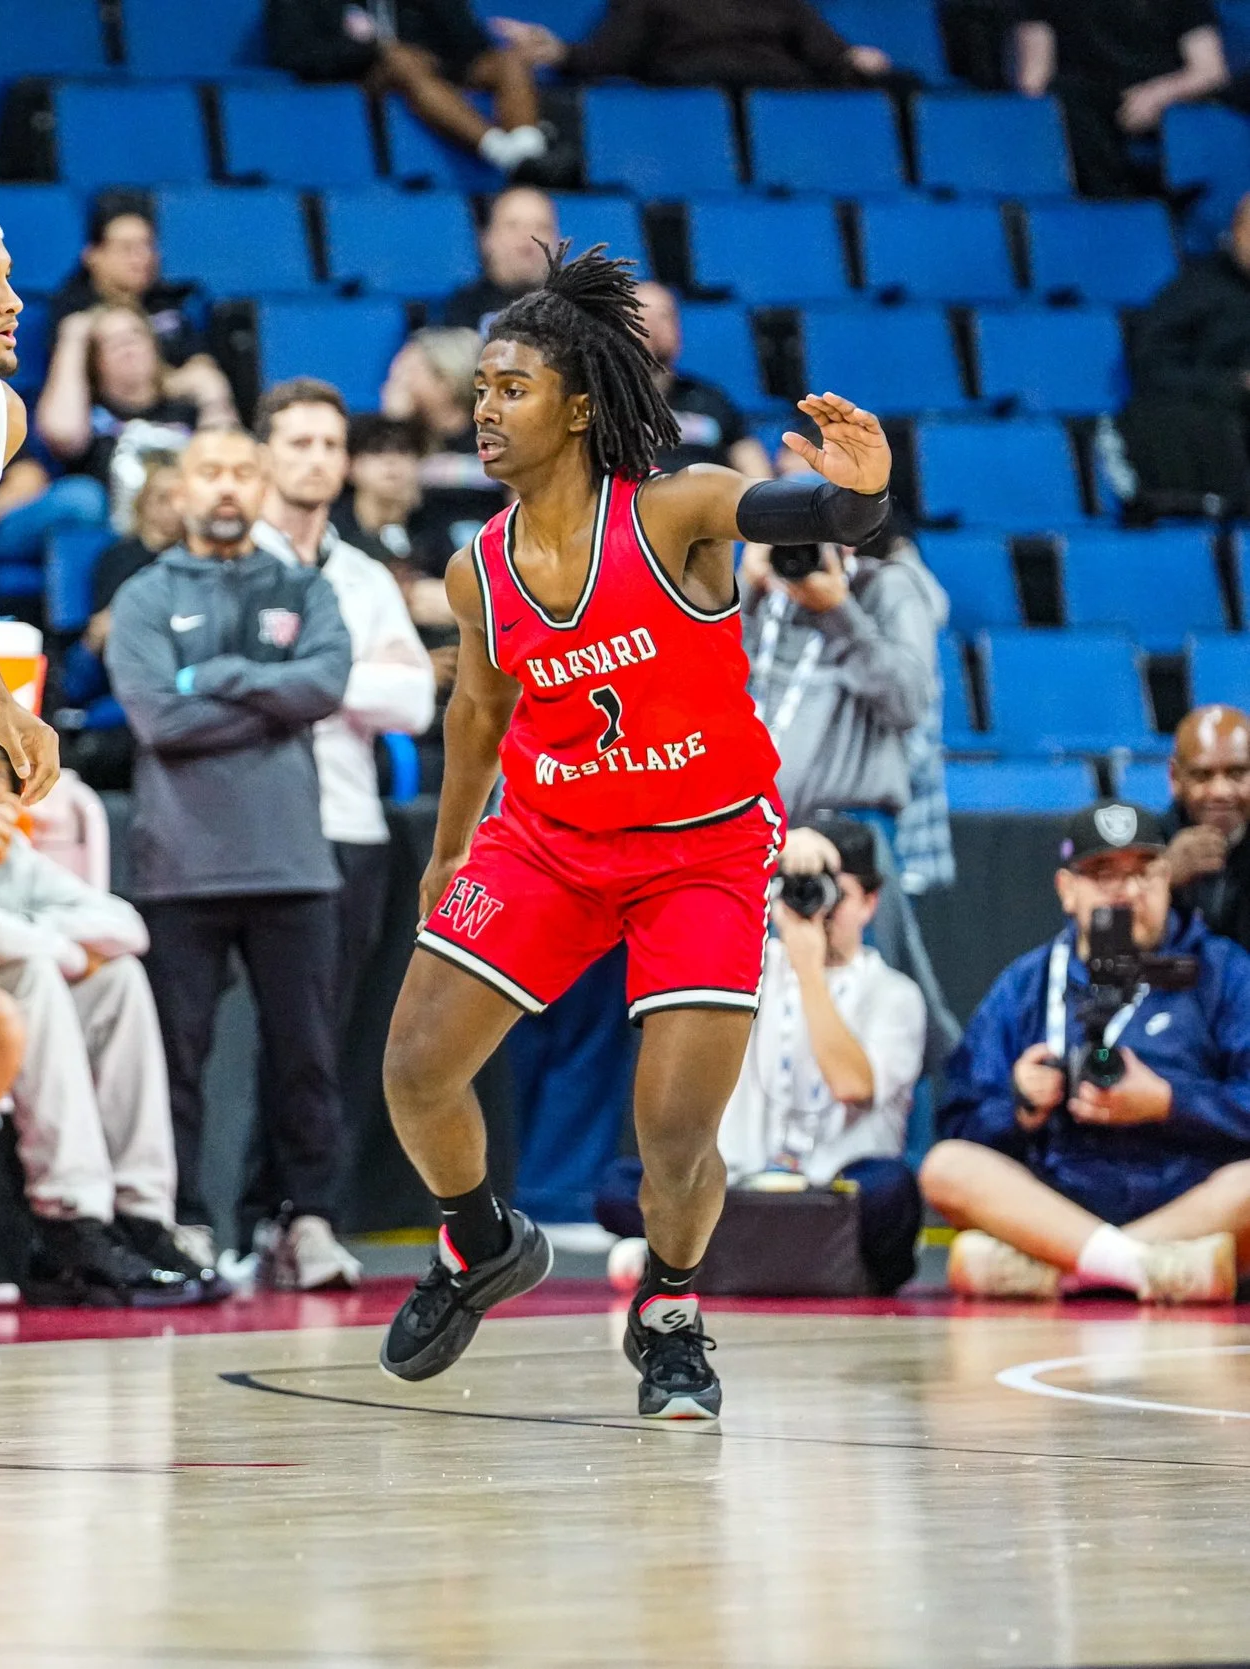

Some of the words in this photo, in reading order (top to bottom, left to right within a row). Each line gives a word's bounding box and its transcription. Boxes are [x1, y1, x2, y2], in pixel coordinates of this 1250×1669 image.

[526, 626, 658, 688] HARVARD
[588, 683, 626, 754] 1
[535, 731, 707, 786] WESTLAKE
